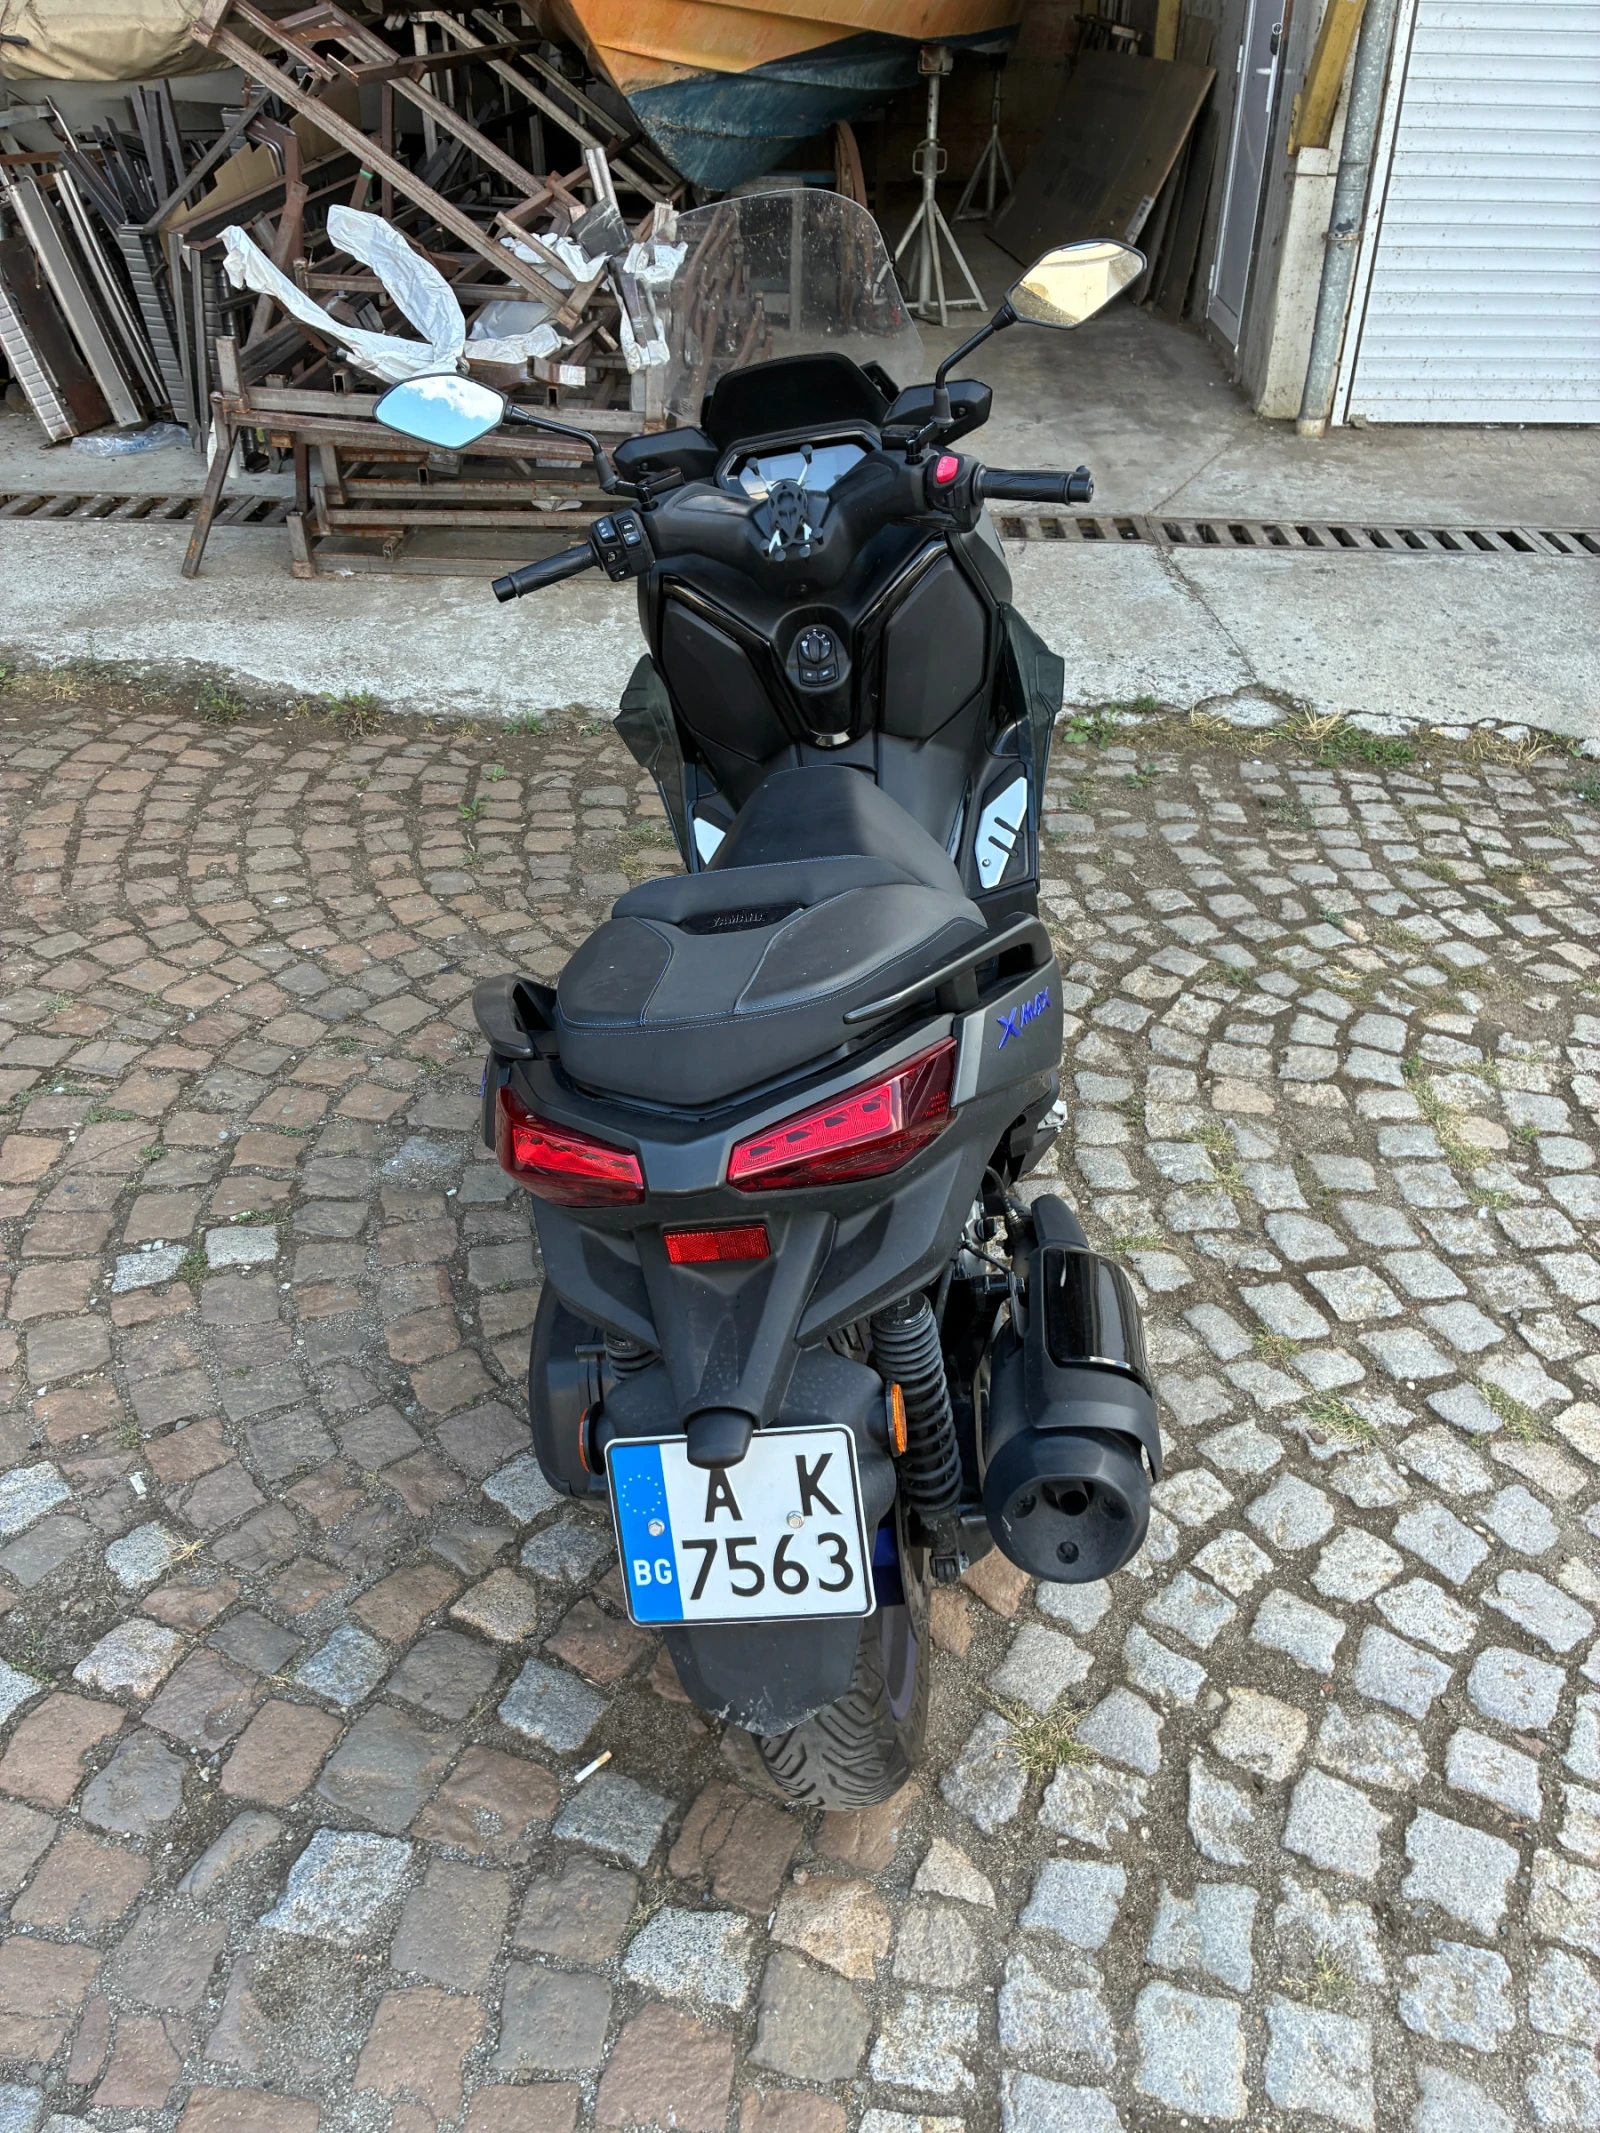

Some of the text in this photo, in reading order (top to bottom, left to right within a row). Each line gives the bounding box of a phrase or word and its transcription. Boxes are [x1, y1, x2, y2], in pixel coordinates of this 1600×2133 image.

[795, 1452, 843, 1516] K
[633, 1558, 672, 1586] BG
[682, 1531, 854, 1600] 7563
